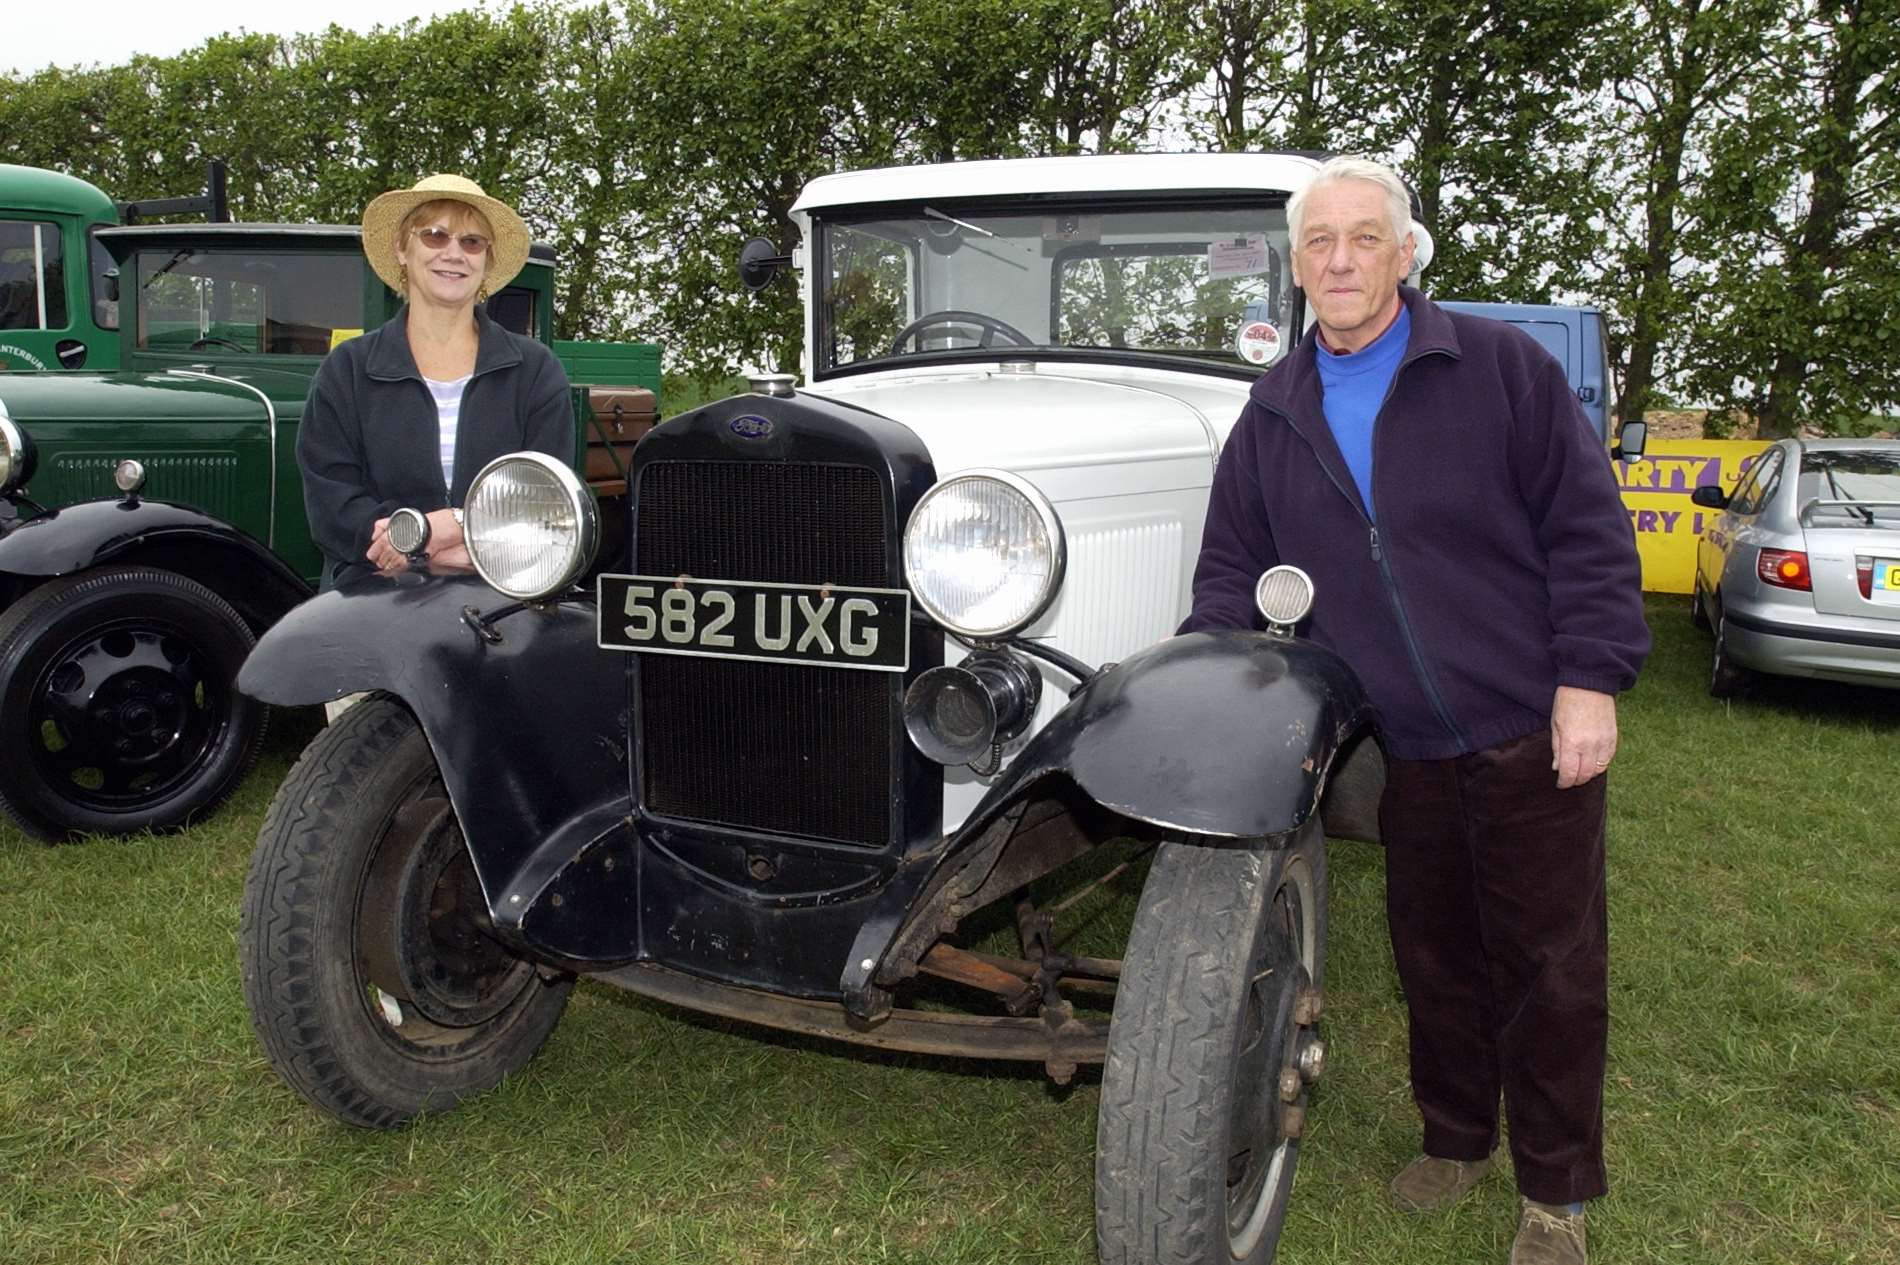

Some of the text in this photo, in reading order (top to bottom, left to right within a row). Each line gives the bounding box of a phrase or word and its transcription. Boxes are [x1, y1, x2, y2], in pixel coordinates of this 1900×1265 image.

[0, 343, 47, 372] NTERBUR
[1612, 459, 1708, 488] ARTY
[624, 585, 879, 657] 582 UXG
